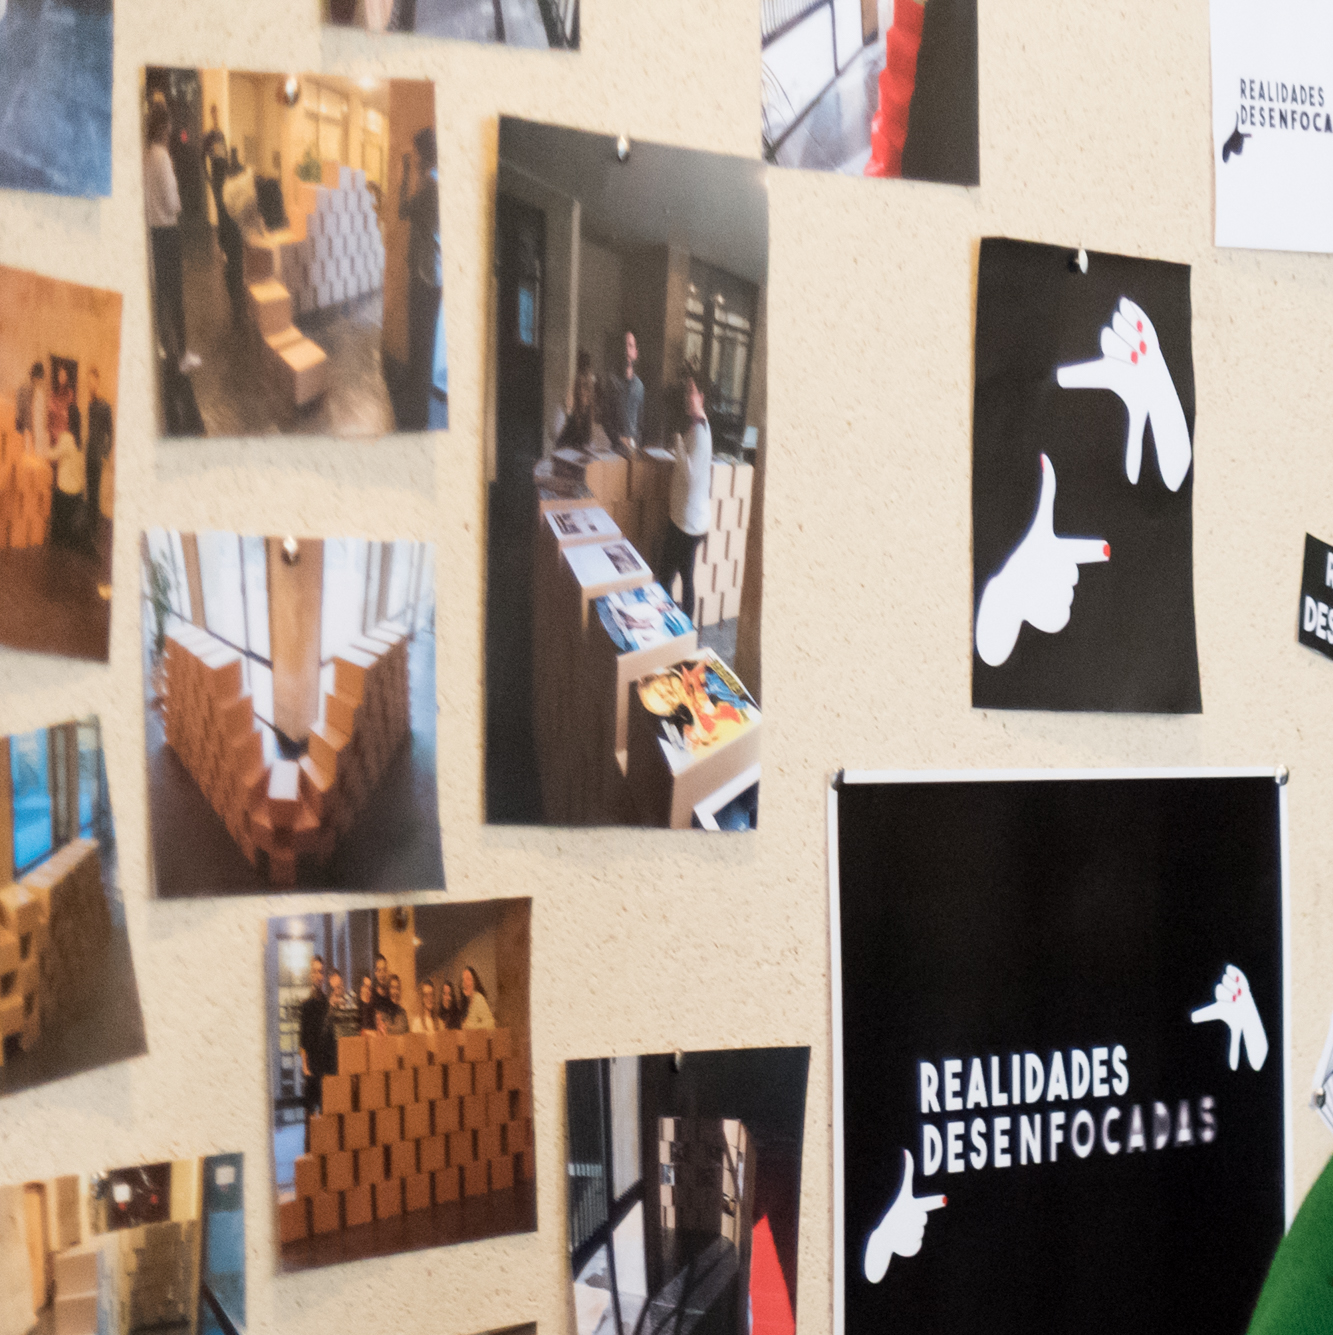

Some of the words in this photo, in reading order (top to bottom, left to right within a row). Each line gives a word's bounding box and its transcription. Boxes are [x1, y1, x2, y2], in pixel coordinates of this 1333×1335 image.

[1240, 77, 1325, 107] REALIDADES
[919, 1044, 1129, 1114] REALIDADES
[922, 1095, 1217, 1176] DESENFOCADAS
